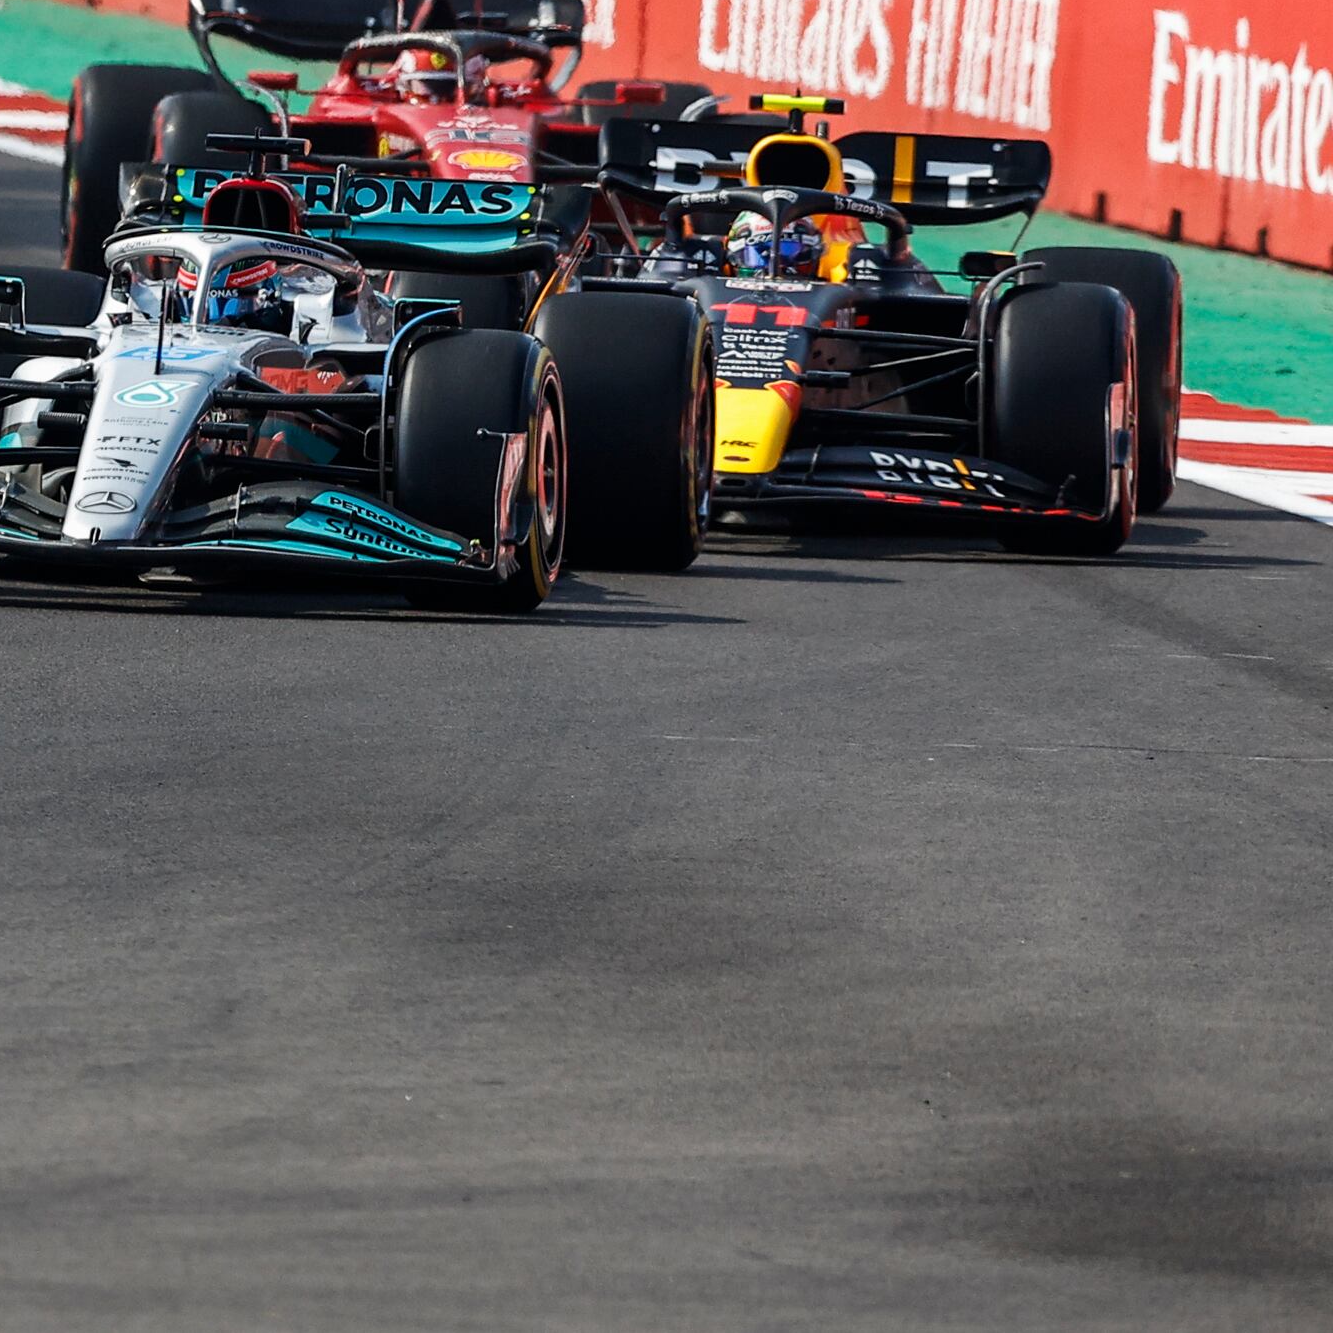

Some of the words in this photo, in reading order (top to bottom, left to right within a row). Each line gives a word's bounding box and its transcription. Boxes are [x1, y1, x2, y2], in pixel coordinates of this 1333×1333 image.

[1146, 8, 1333, 196] Emirate
[192, 169, 514, 217] PRONAS
[845, 199, 876, 215] Tezos
[709, 303, 809, 327] 11
[118, 436, 162, 446] FTX
[328, 495, 433, 543] PETRONAS
